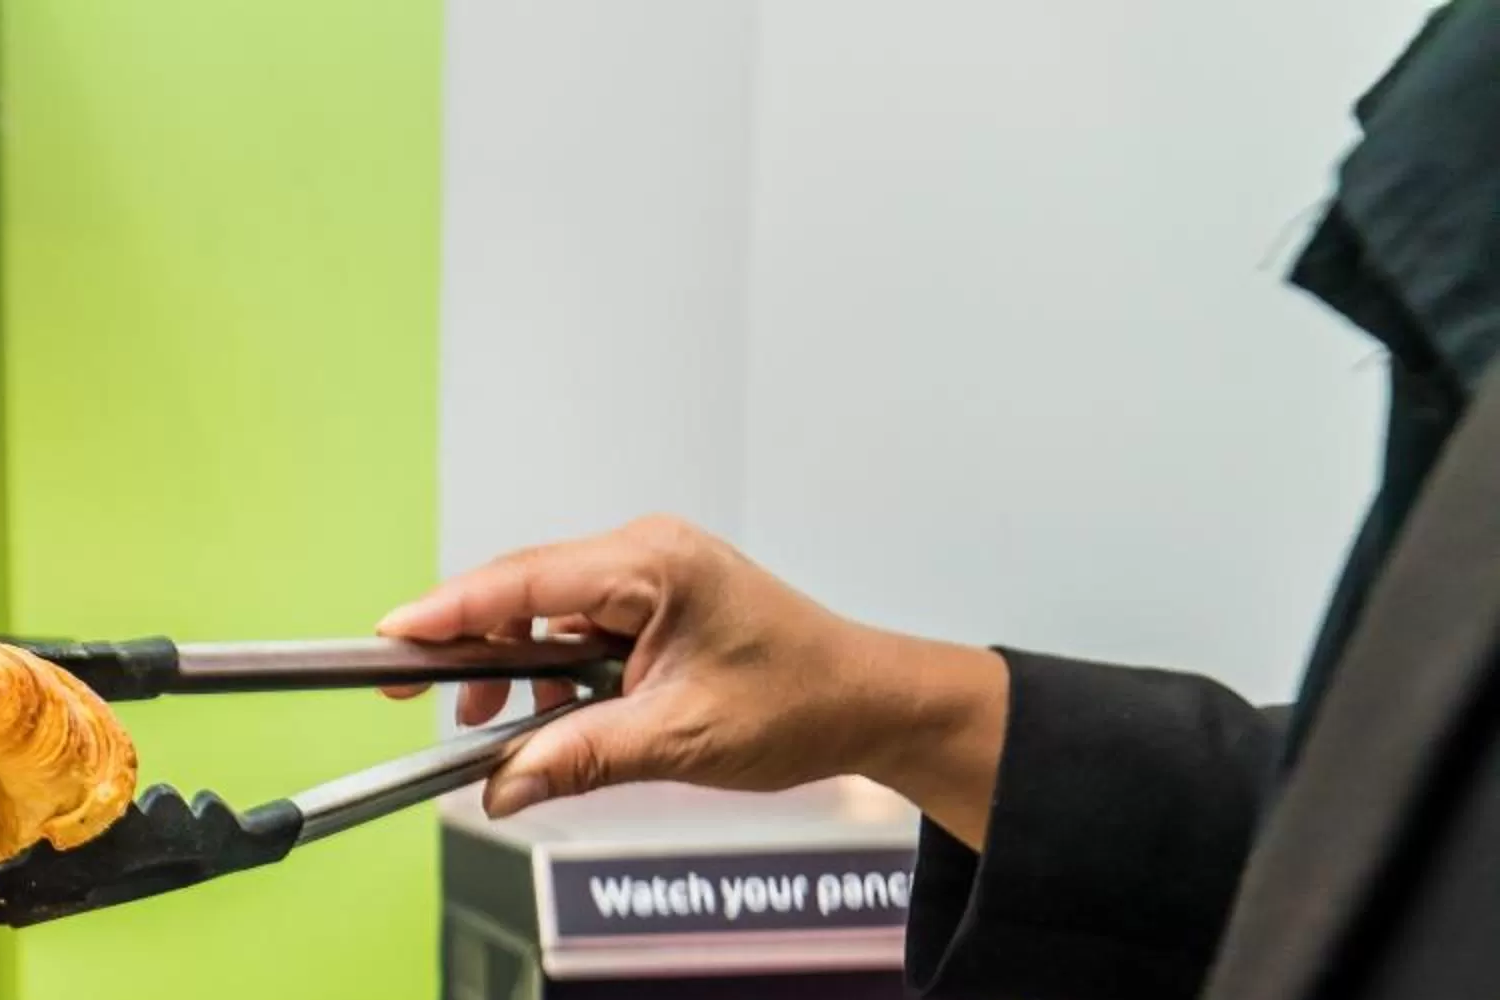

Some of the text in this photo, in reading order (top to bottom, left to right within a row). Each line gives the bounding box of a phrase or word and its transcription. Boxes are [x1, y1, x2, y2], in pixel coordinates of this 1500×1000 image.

[590, 870, 915, 920] Watch your panc
